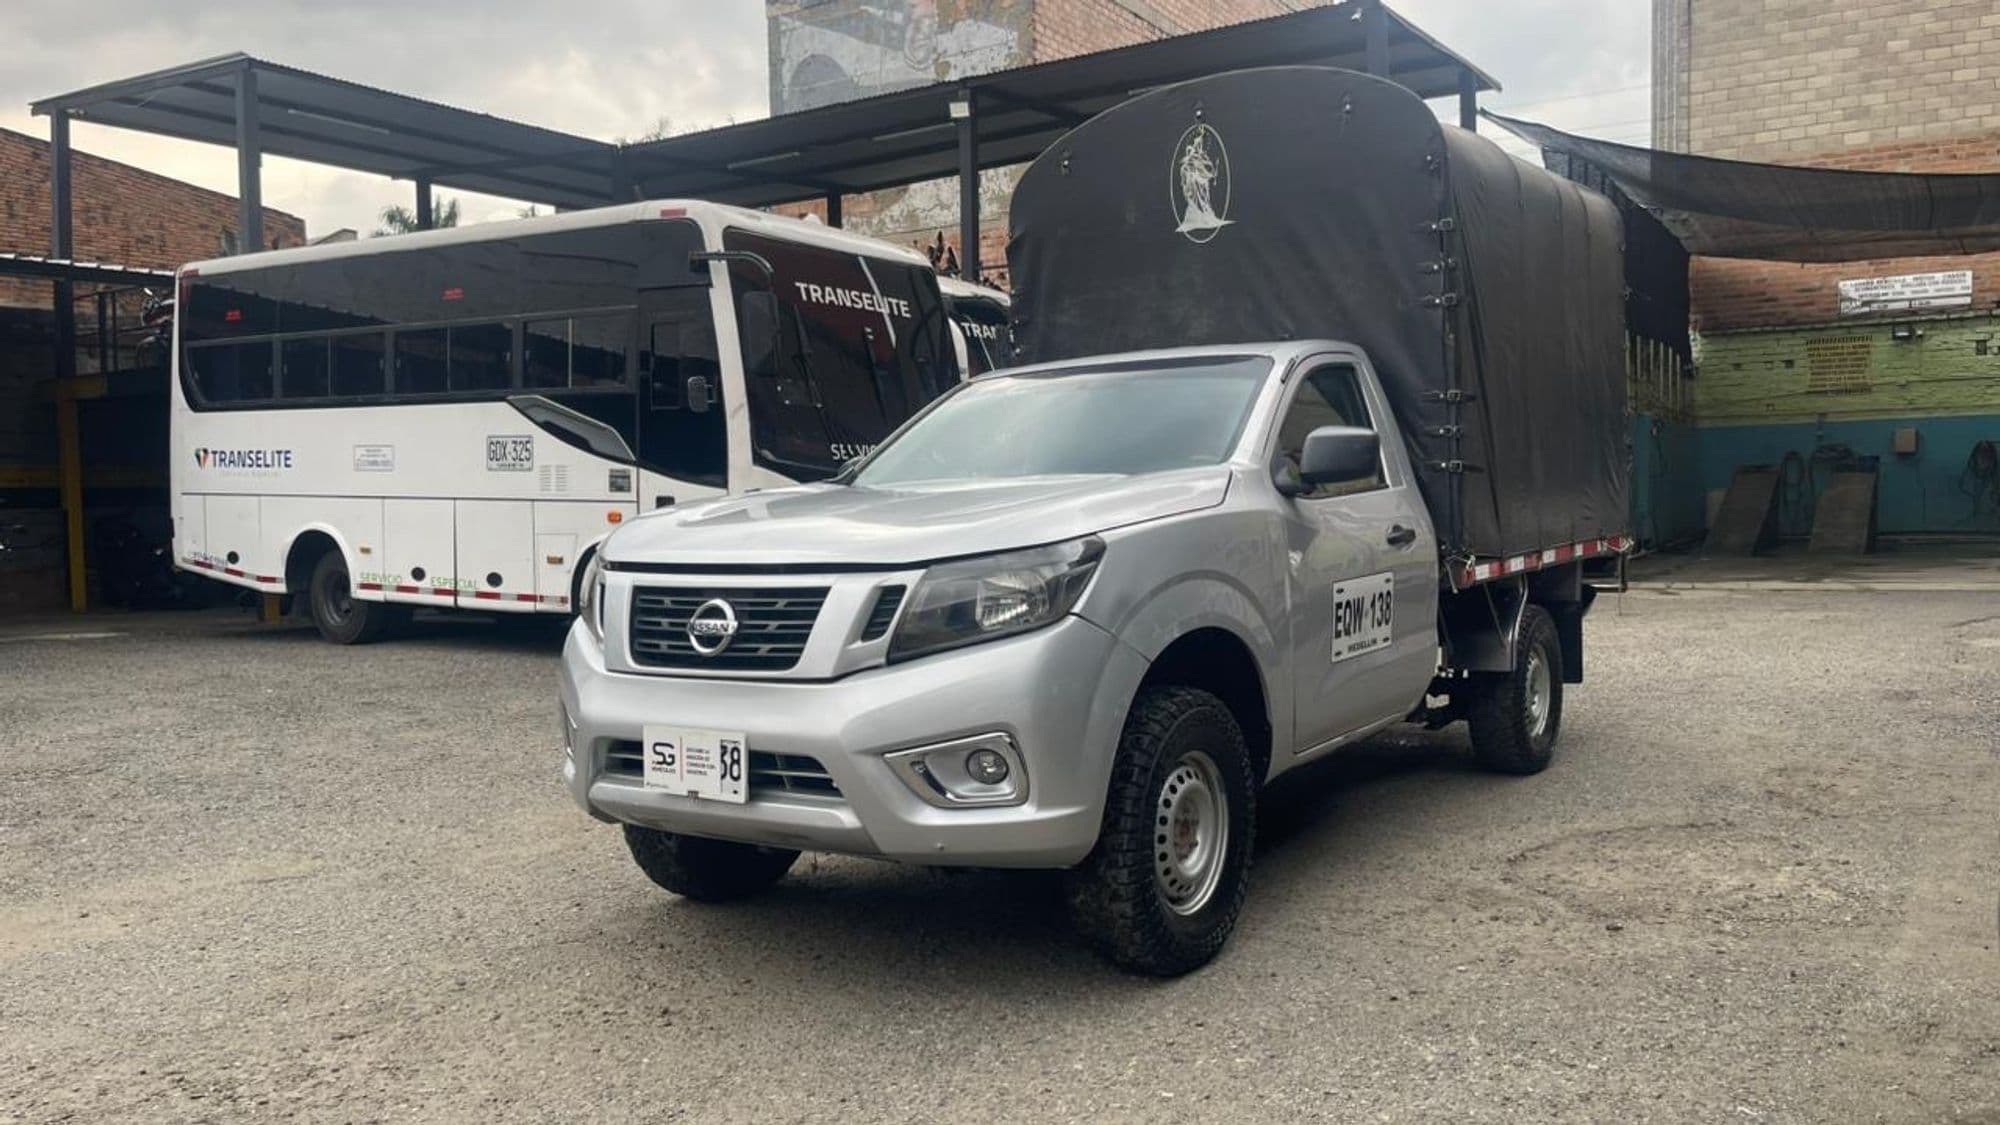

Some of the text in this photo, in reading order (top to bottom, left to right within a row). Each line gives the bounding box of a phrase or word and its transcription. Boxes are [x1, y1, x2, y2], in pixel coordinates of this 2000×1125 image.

[795, 281, 912, 318] TRANSELITE
[211, 450, 293, 469] TRANSELITE
[359, 572, 479, 588] SERVICIO ESPECIAL
[690, 622, 730, 633] NISSAN
[720, 744, 741, 782] 38
